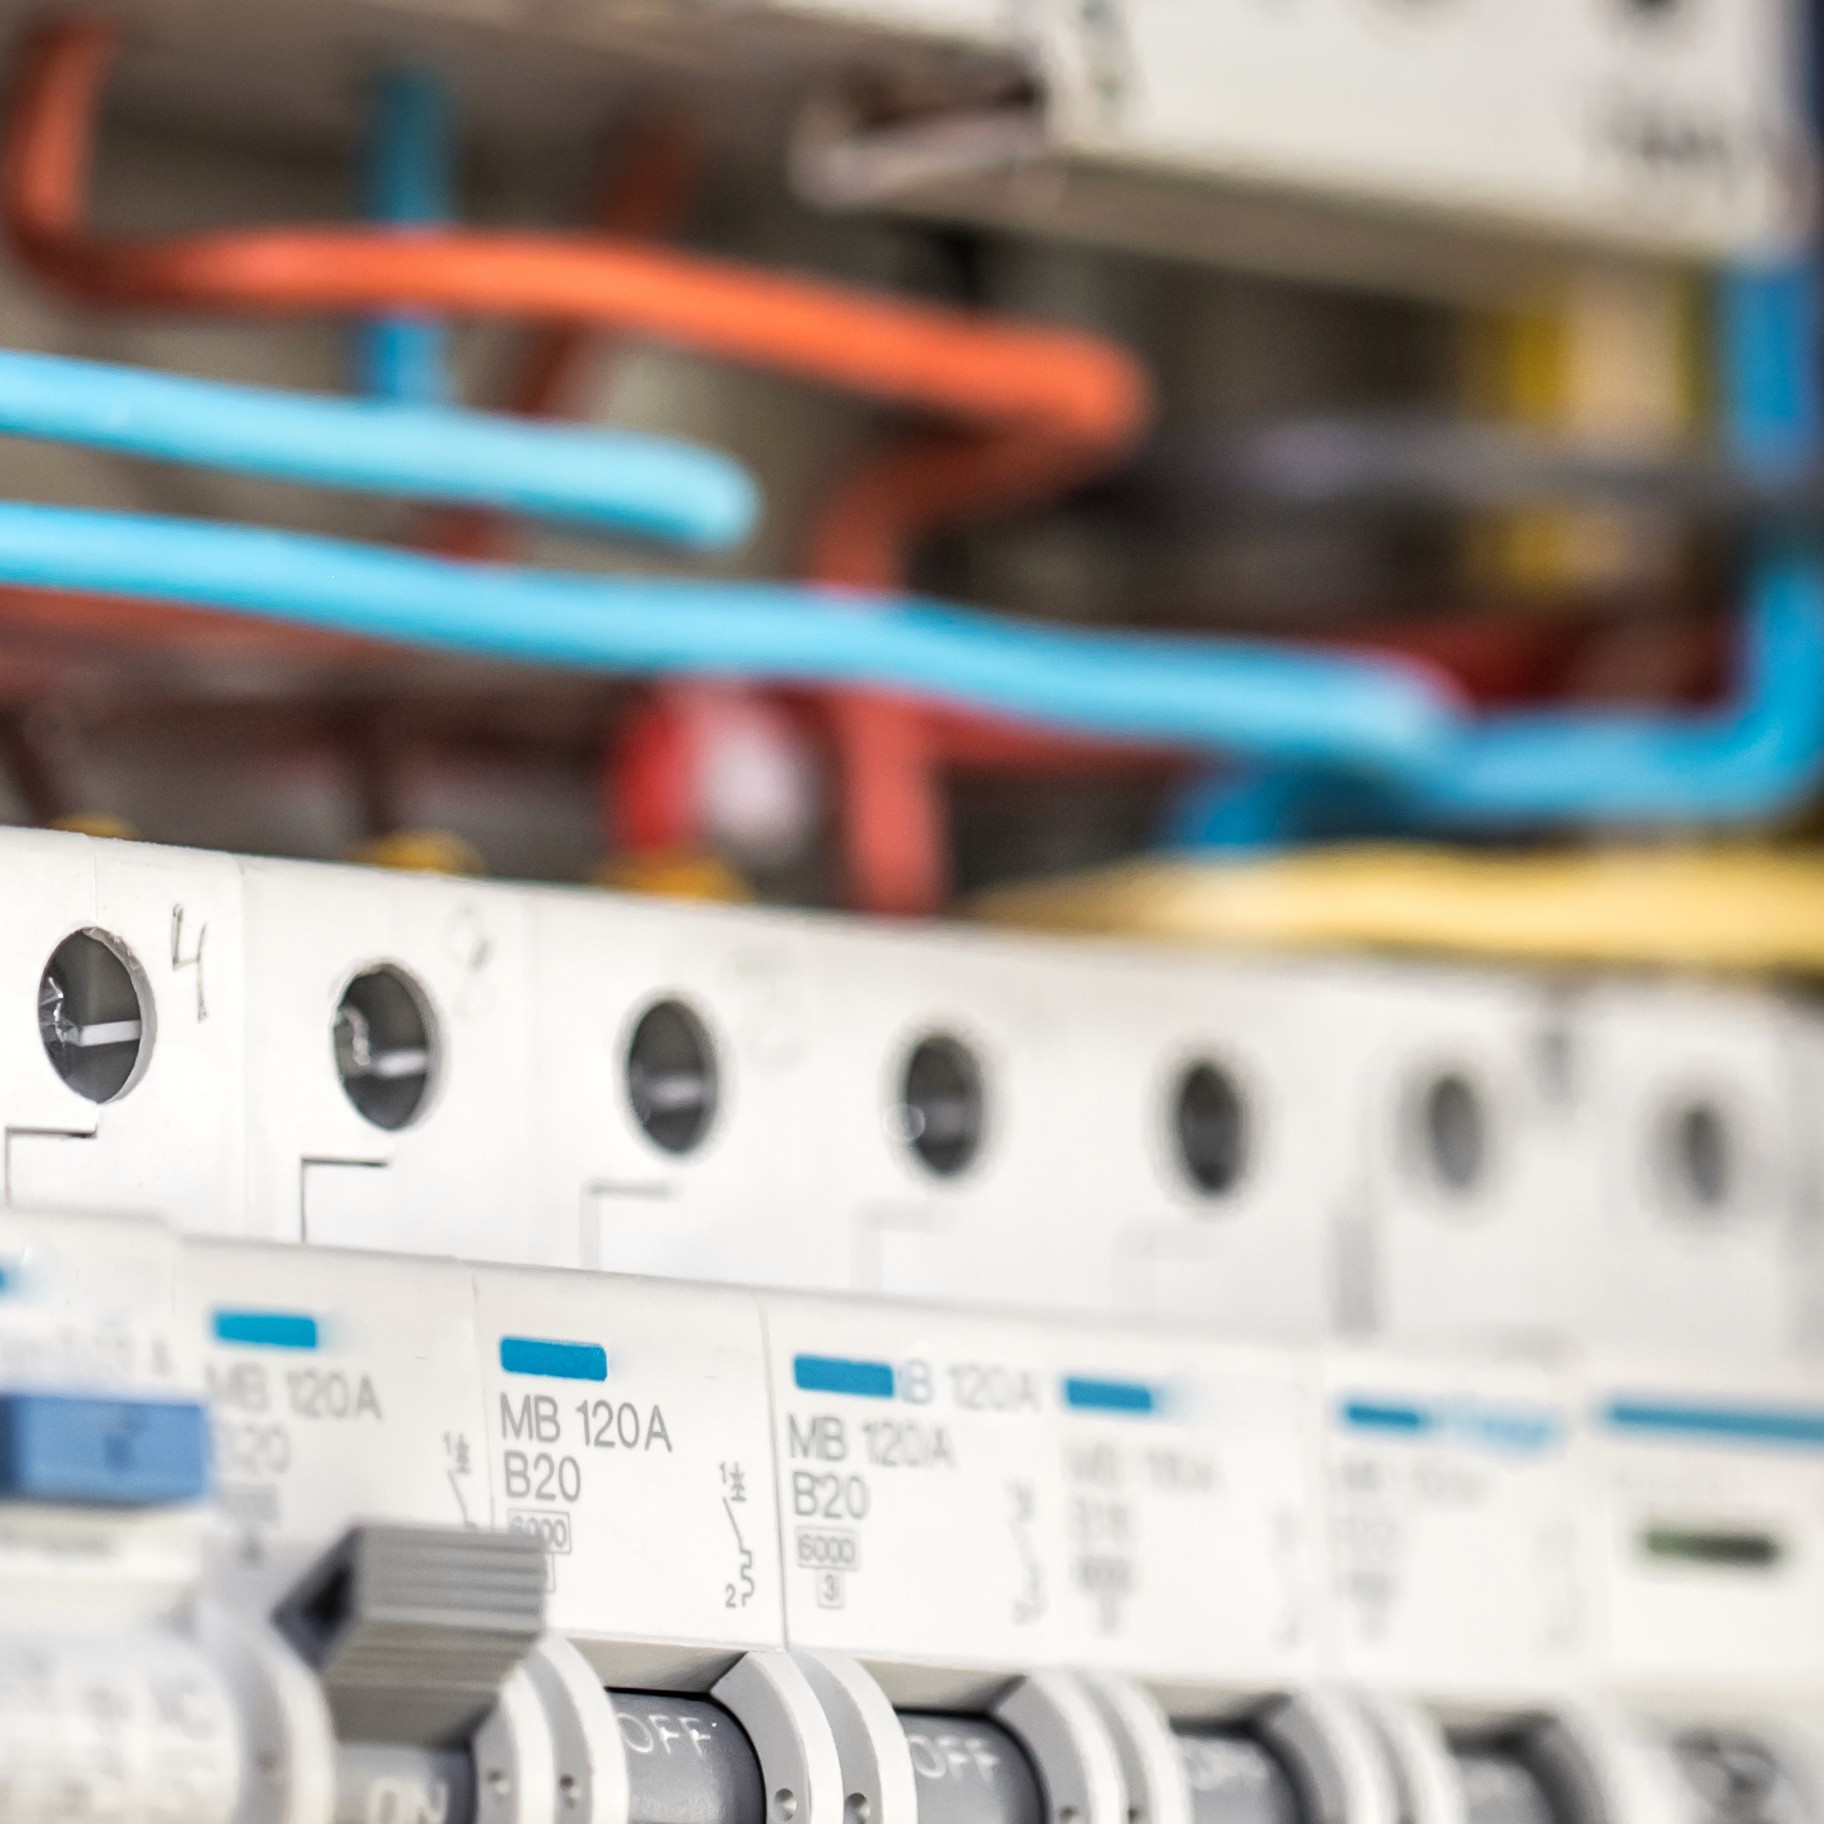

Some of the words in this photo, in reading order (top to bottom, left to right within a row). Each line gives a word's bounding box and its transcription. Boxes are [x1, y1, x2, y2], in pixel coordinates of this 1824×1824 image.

[172, 902, 207, 1023] 4
[500, 1392, 561, 1444] MB
[575, 1399, 673, 1454] 120A
[788, 1413, 849, 1463] MB
[861, 1419, 961, 1471] 120A
[504, 1450, 581, 1503] B20
[792, 1471, 871, 1520] B20
[797, 1533, 857, 1565] 6000
[725, 1583, 737, 1608] 2
[615, 1712, 712, 1757] OFF
[907, 1734, 1000, 1781] OFF
